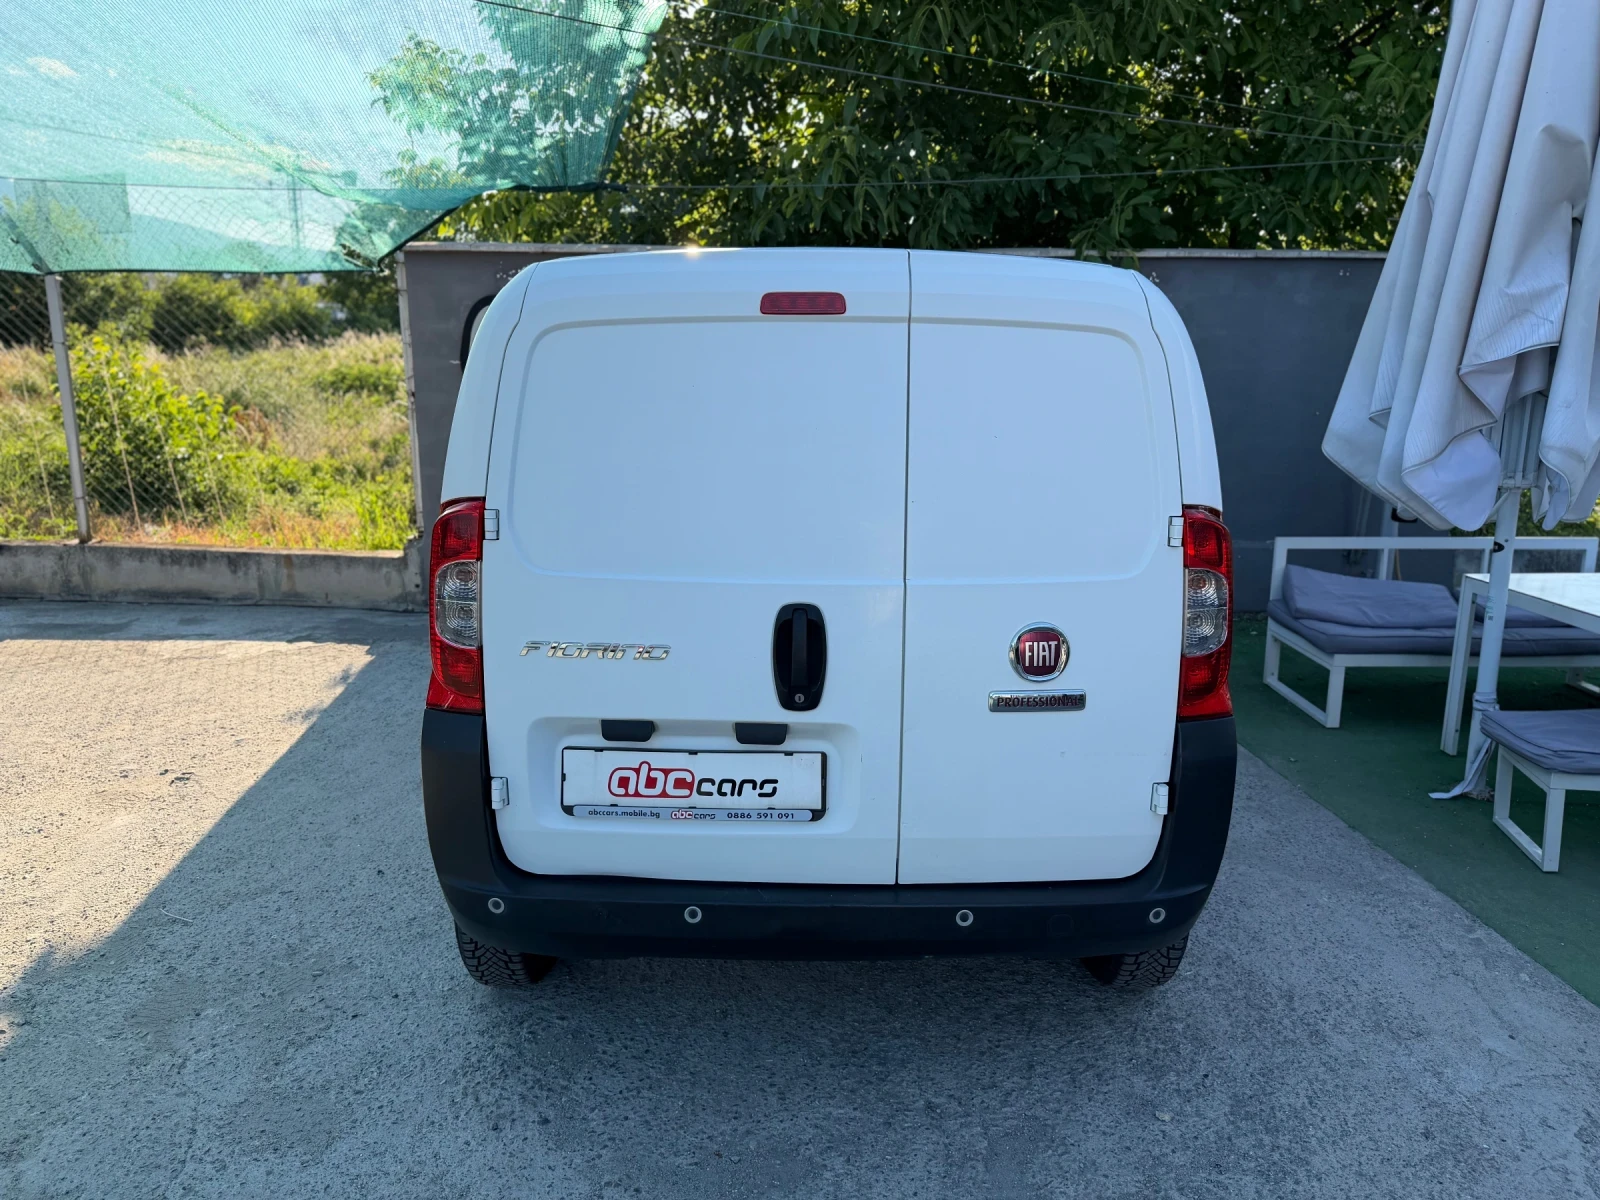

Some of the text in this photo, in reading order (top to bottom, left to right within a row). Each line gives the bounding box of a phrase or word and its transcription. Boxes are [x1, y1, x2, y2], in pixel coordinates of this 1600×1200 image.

[1025, 641, 1058, 667] FIAT
[997, 696, 1080, 708] PROFESSIONAL
[588, 808, 660, 819] abccars.mobile.bg
[726, 812, 795, 820] 0886 591 091
